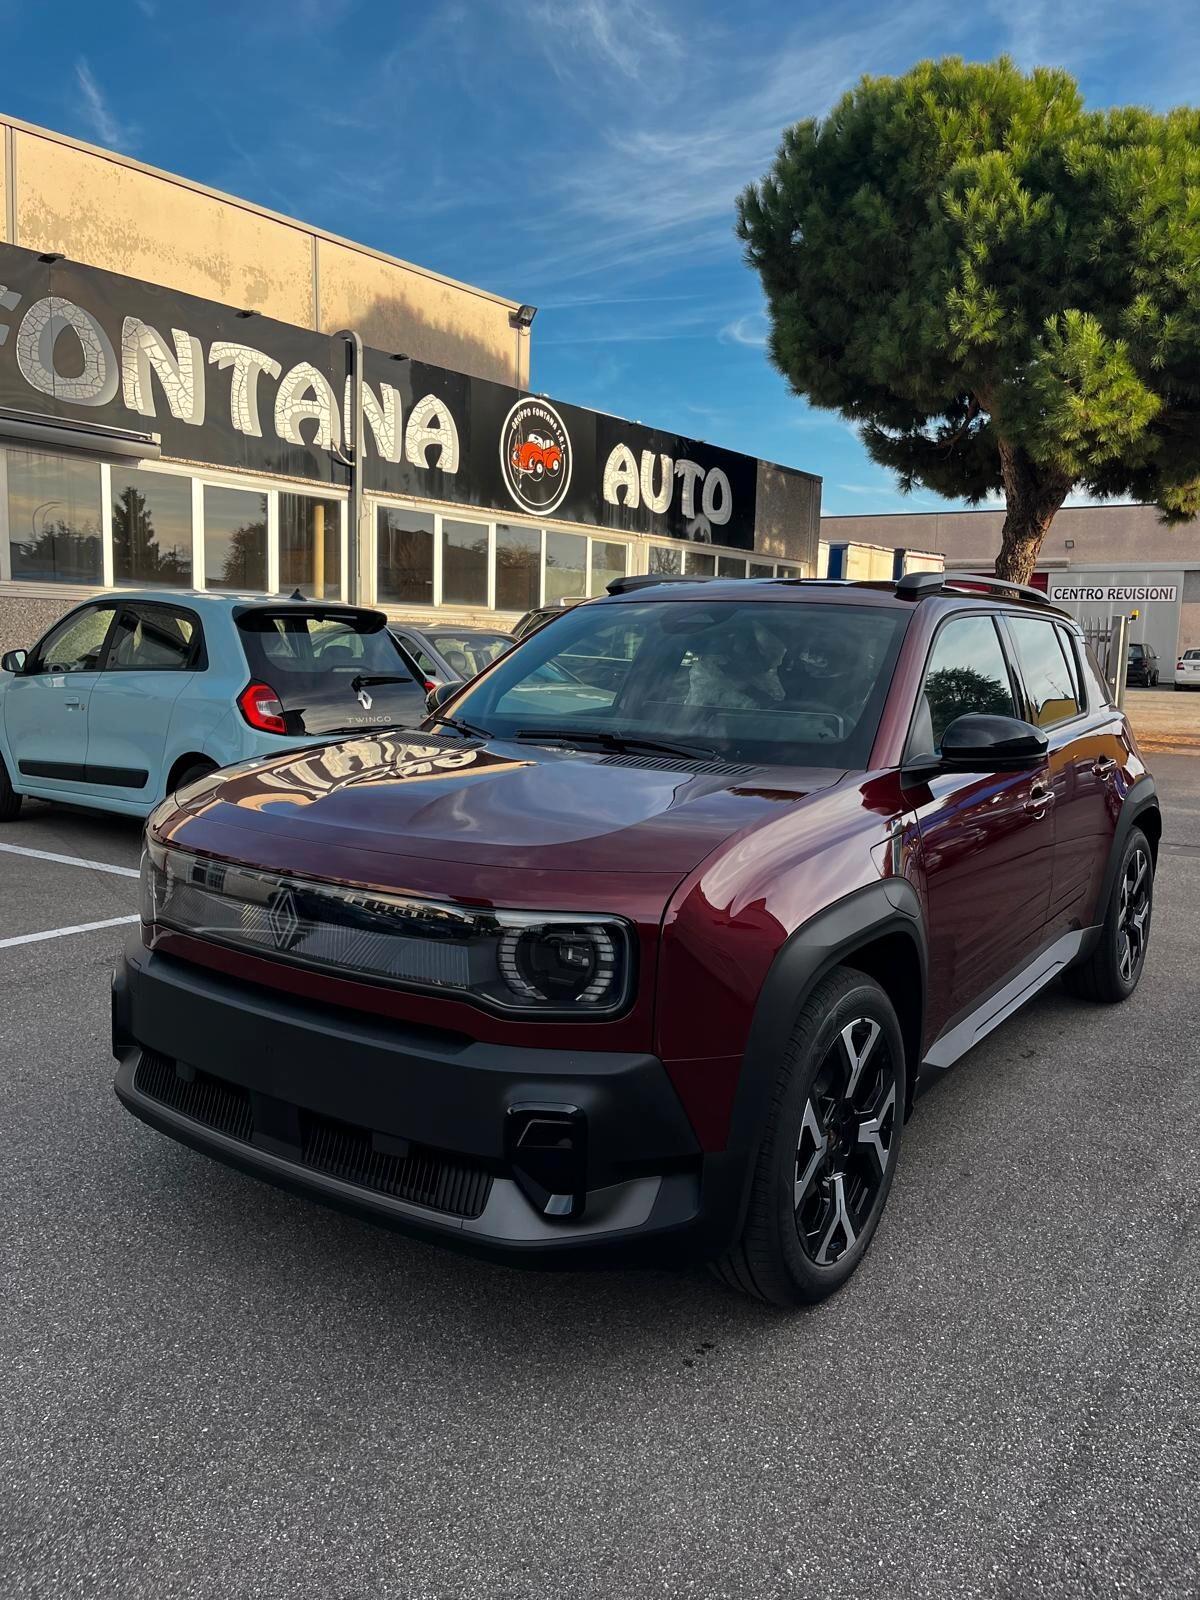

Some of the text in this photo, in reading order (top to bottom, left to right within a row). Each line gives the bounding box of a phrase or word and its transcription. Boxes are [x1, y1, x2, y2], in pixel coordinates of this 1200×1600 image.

[0, 284, 733, 526] ONTANA AUTO
[532, 407, 558, 430] FONTANA
[1054, 588, 1174, 601] CENTRO REVISIONI
[346, 716, 392, 724] TWINGO
